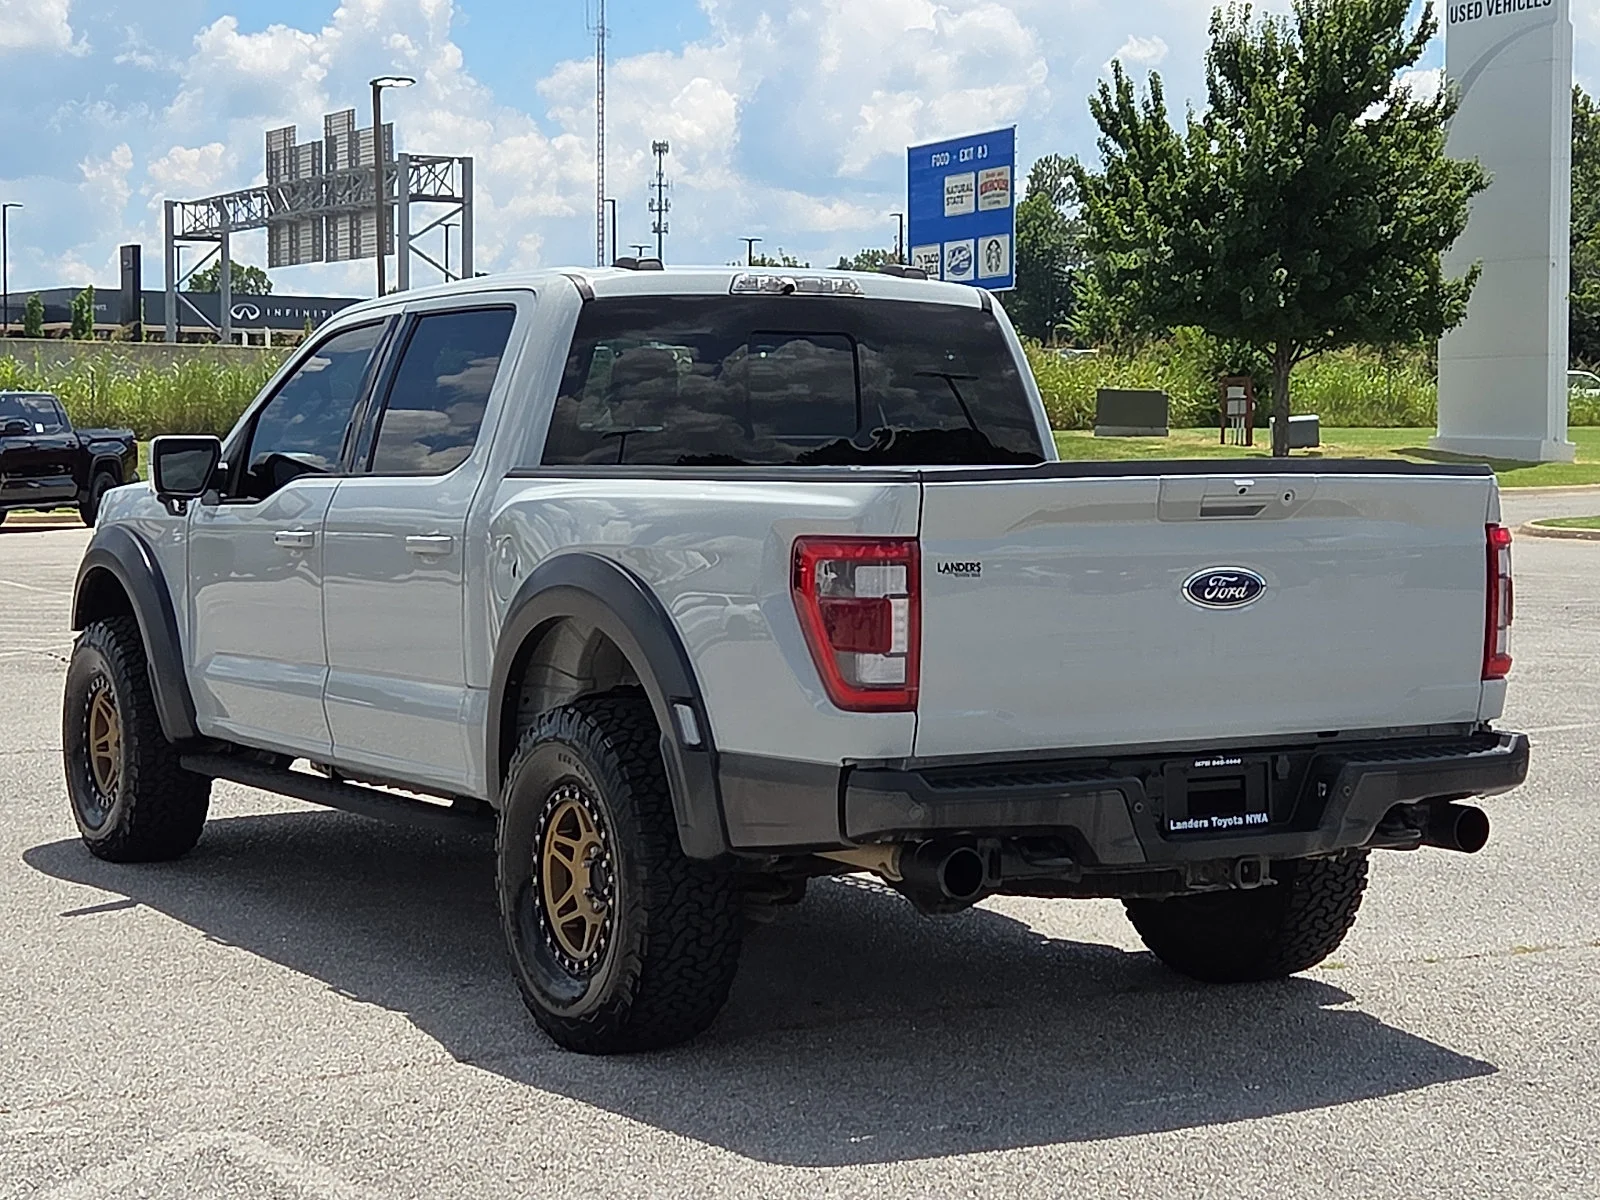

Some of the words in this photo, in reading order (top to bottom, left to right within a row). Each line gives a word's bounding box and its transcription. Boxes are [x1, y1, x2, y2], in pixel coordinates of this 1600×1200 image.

[1450, 1, 1483, 24] USED
[931, 152, 950, 167] FOOD
[960, 147, 974, 162] EXIT
[946, 183, 974, 195] NATURAL
[946, 195, 964, 206] STATE
[924, 253, 939, 264] TACO
[937, 562, 981, 574] LANDERS
[1204, 576, 1249, 599] Ford
[1170, 818, 1208, 830] Landers
[1211, 816, 1243, 828] Toyota
[1246, 813, 1268, 824] NWA
